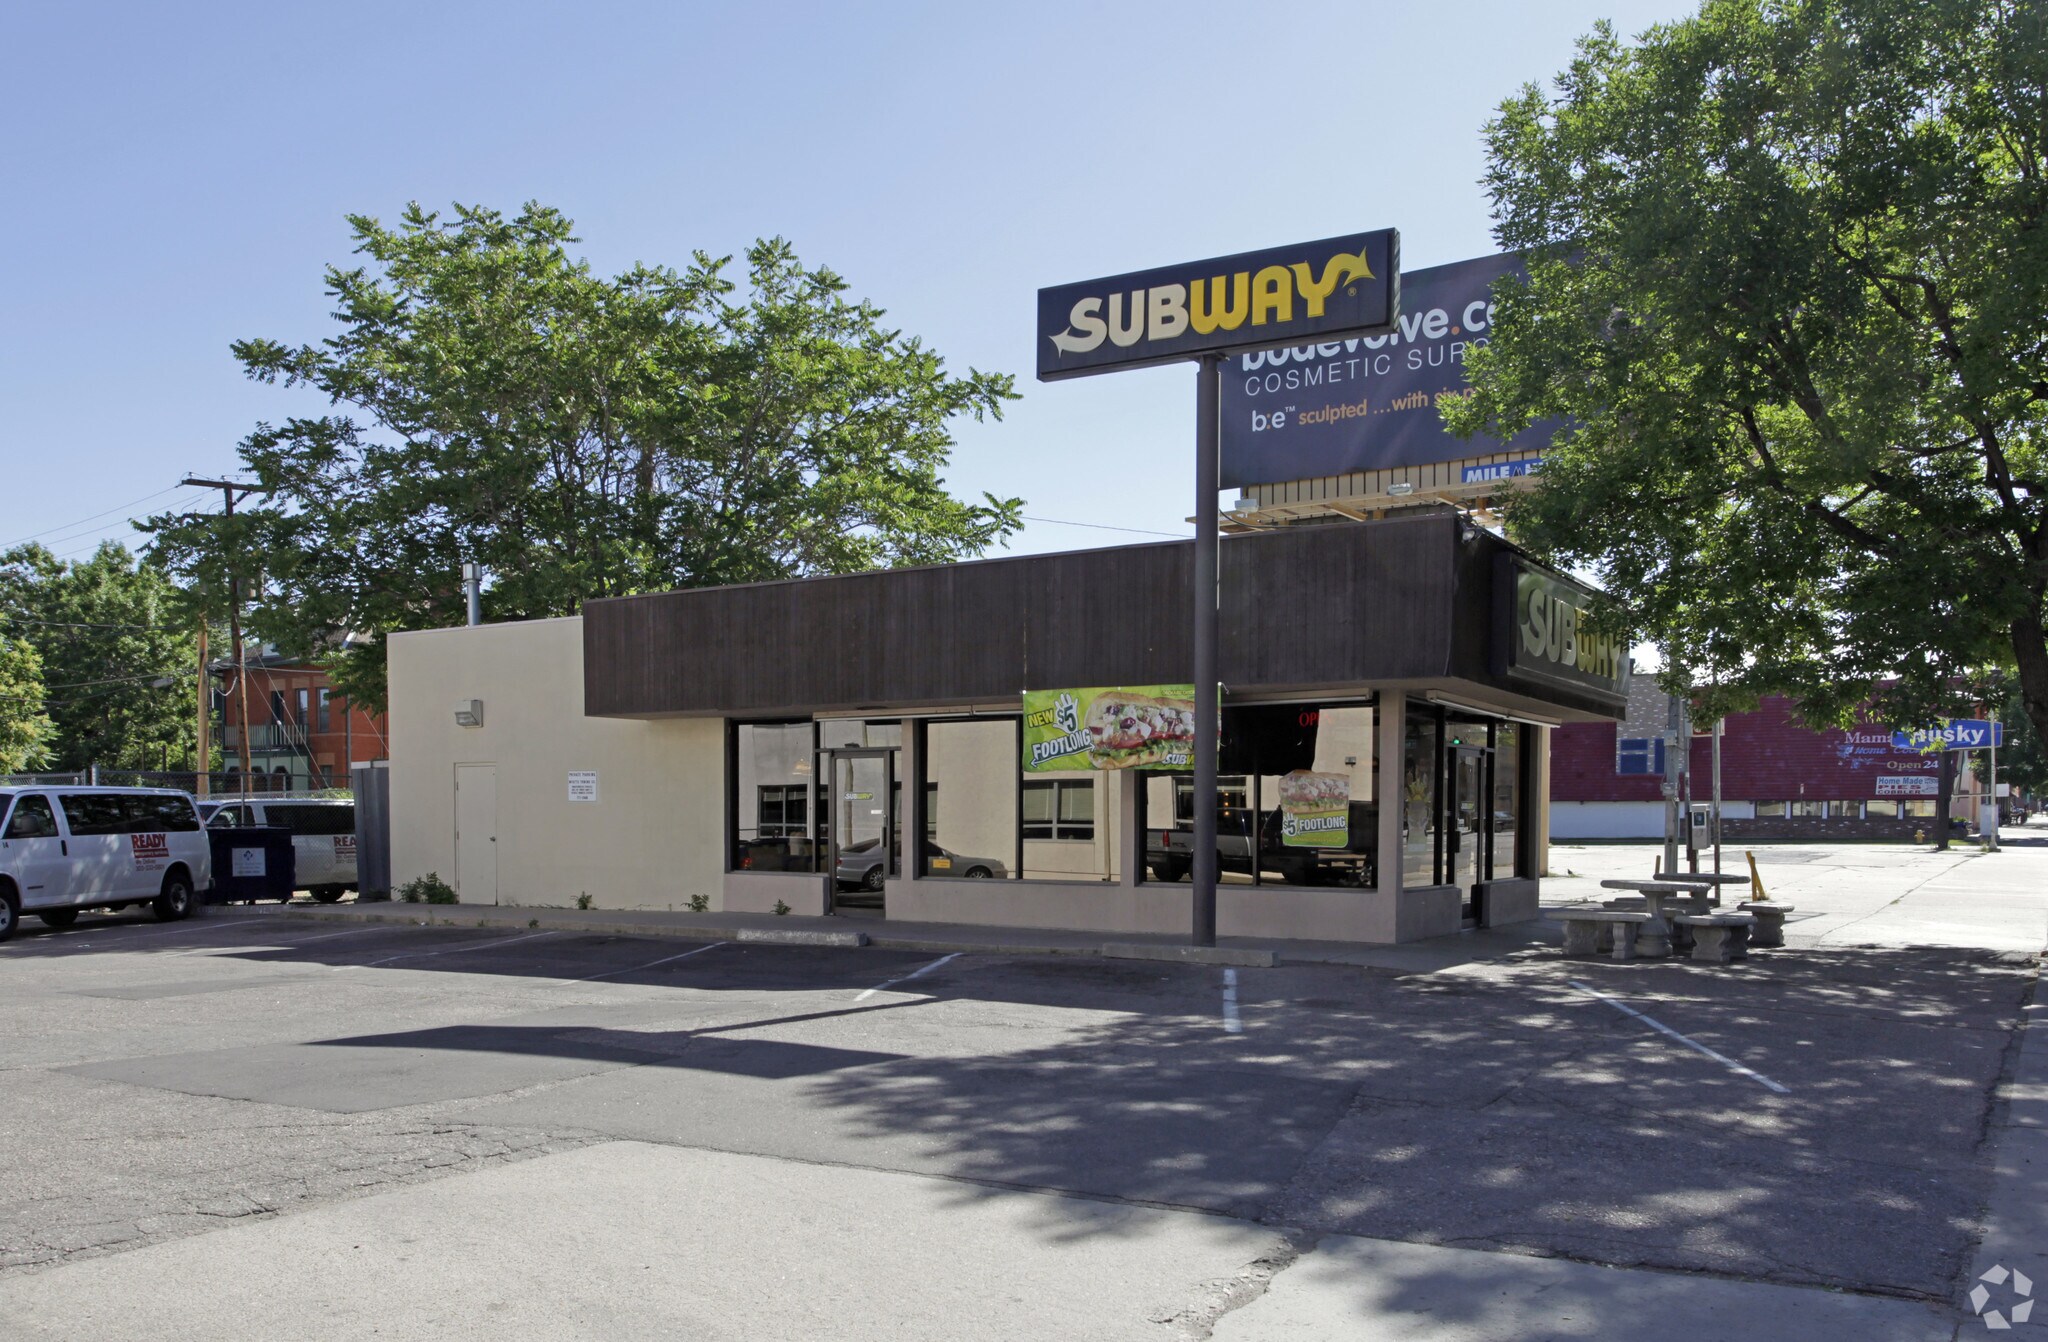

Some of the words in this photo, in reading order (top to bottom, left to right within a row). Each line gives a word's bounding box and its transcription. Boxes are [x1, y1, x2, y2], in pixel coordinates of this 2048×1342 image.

[1049, 247, 1376, 358] SUBWAY
[1246, 354, 1390, 396] COSMETIC
[1299, 400, 1367, 425] sculpted
[1466, 466, 1510, 483] MILE
[1028, 709, 1053, 727] NEW
[1056, 704, 1077, 732] $5
[1032, 729, 1090, 761] FOOTLONG
[1162, 753, 1194, 765] SUBW
[1886, 761, 1921, 771] Open
[1922, 760, 1939, 769] 24
[1878, 777, 1901, 785] Home
[1903, 777, 1923, 785] Made
[1283, 820, 1296, 836] $5
[1299, 816, 1346, 831] FOOTLONG
[131, 833, 166, 849] READY
[333, 836, 356, 847] REA
